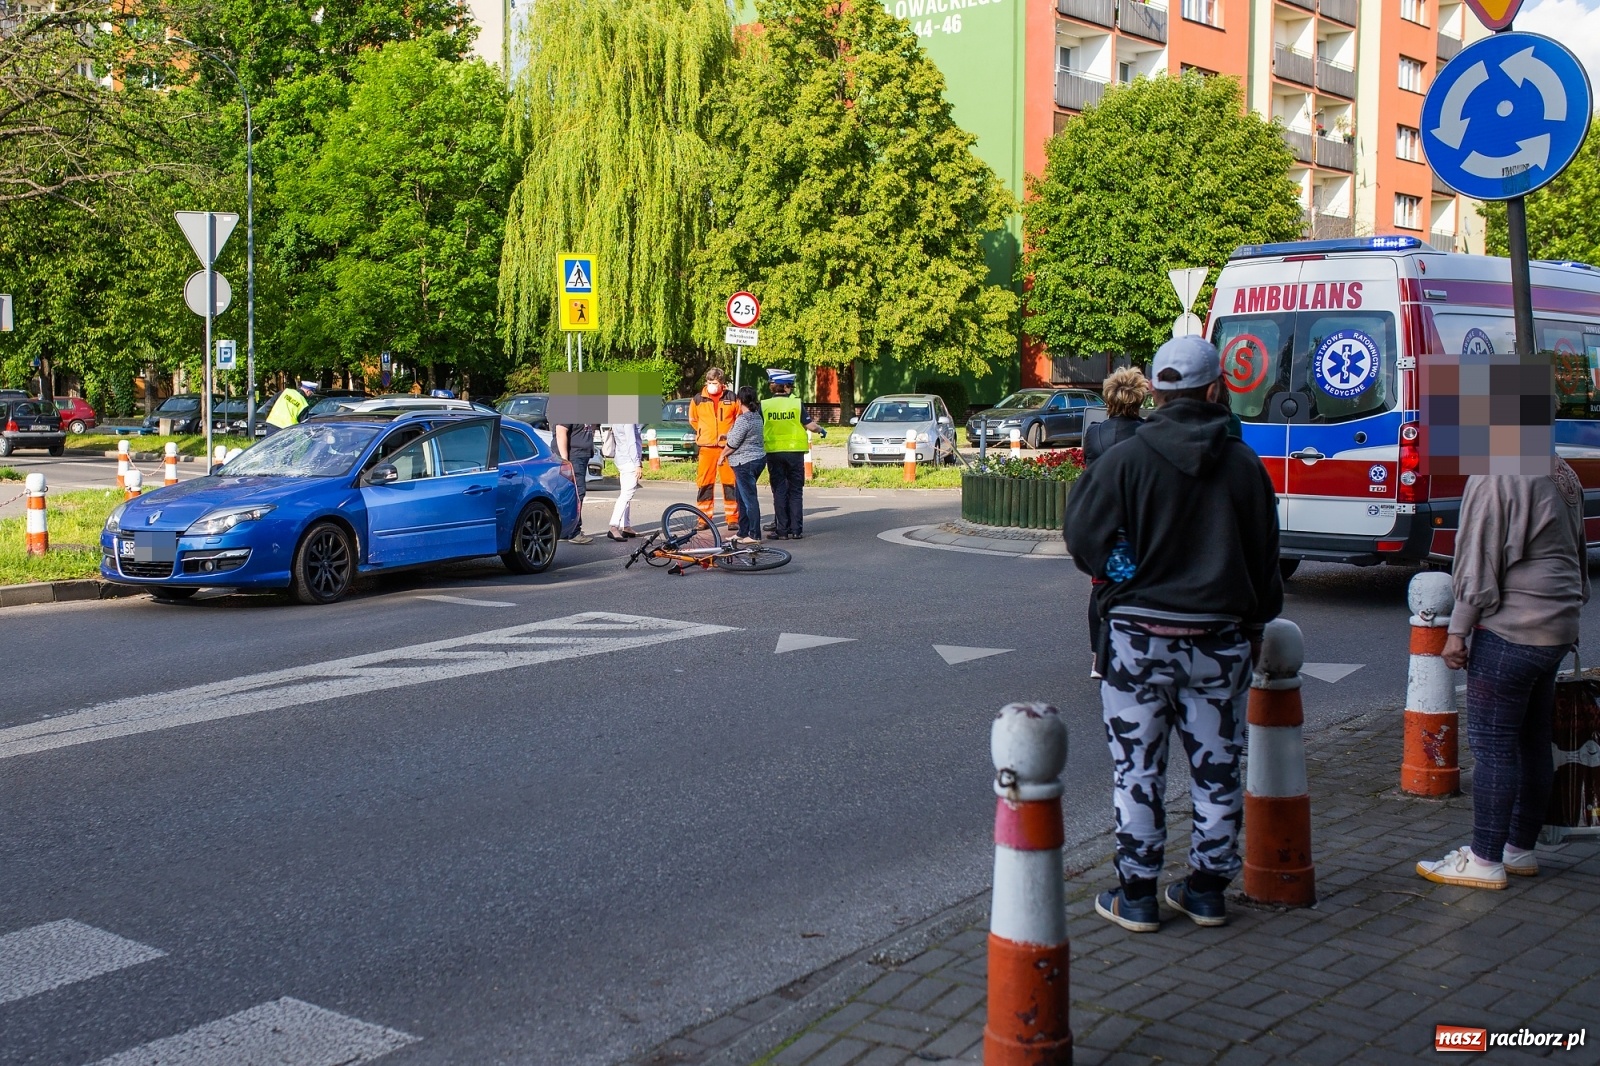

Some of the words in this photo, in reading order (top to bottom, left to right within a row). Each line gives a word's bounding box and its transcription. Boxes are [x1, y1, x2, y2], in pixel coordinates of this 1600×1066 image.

[914, 13, 962, 38] 44-46
[733, 301, 755, 316] 2,5t
[1233, 282, 1363, 313] AMBULANS
[221, 348, 231, 362] P
[1233, 347, 1253, 381] S
[1314, 332, 1344, 378] PAŃSTWOWE
[1353, 332, 1379, 378] RATOWNICTWO
[1324, 383, 1366, 397] MEDYCZNE
[768, 411, 796, 421] POLICJA
